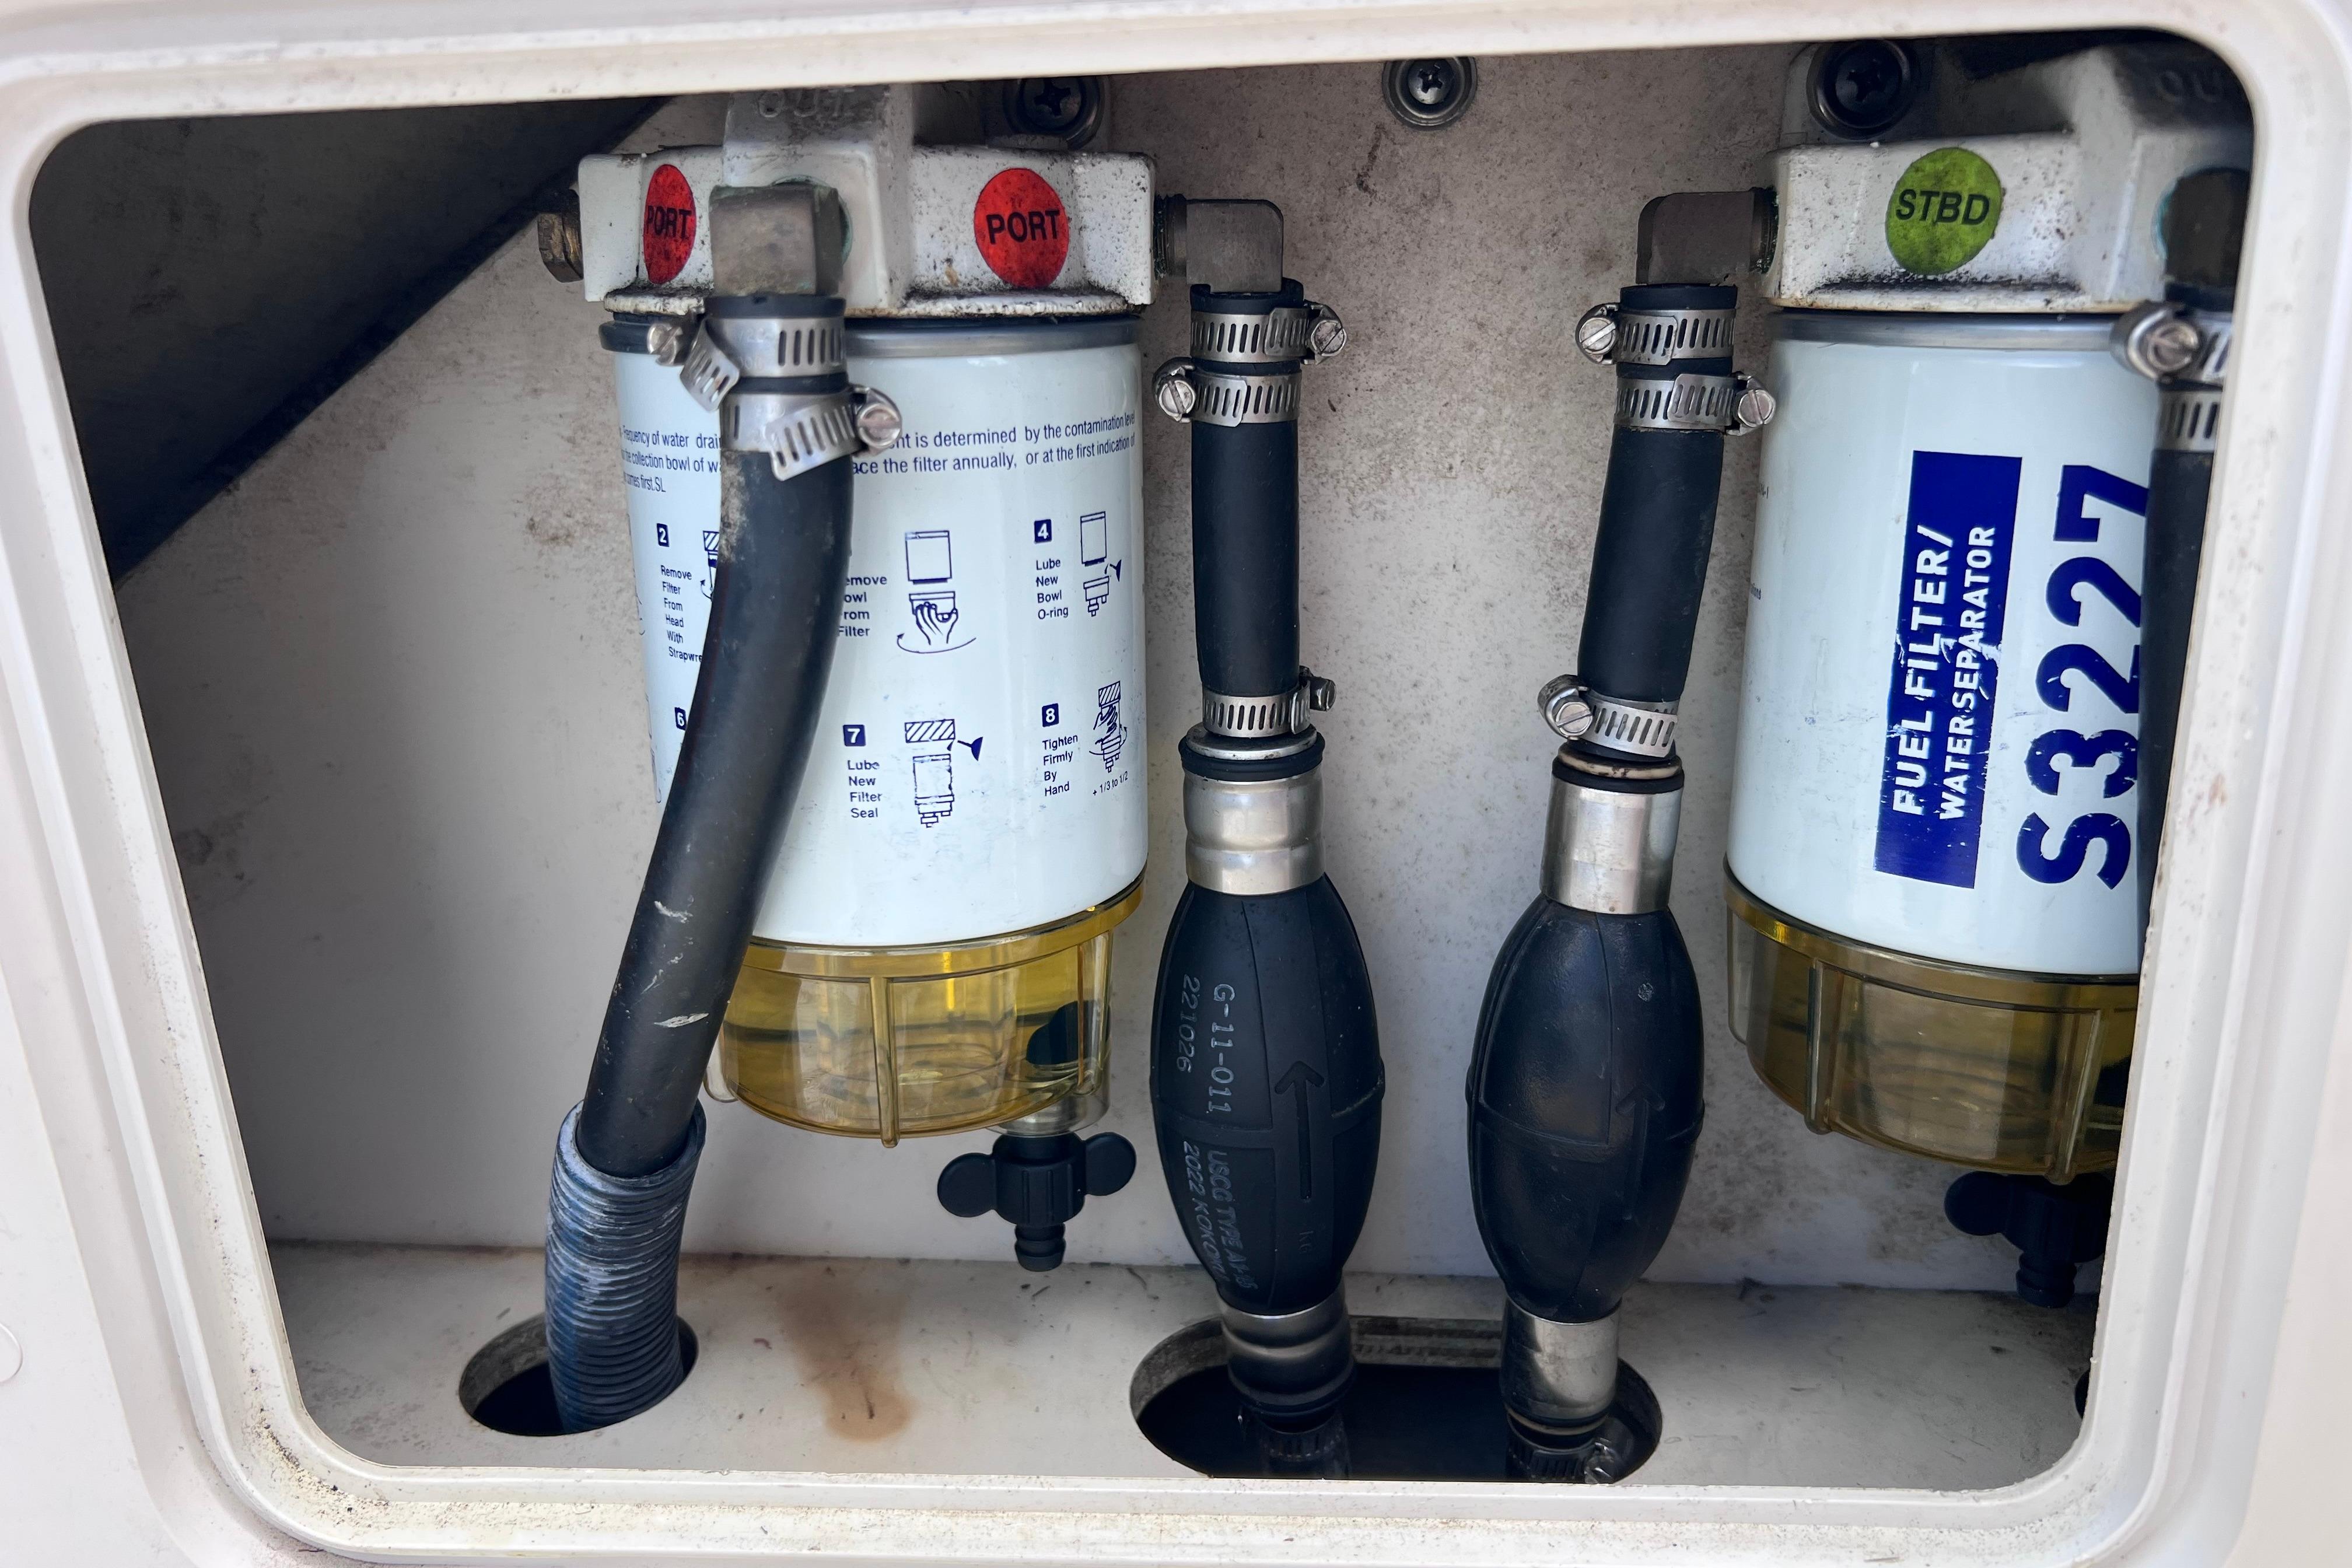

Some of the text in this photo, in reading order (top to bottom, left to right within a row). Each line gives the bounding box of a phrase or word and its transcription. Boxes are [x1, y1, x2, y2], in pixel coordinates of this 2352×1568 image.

[1895, 188, 1989, 226] STBD
[647, 205, 692, 240] PORT
[986, 209, 1061, 244] PORT
[915, 432, 929, 448] is
[933, 427, 1017, 448] determined
[1025, 426, 1040, 444] by
[1044, 424, 1061, 440] the
[1065, 414, 1124, 437] contamination
[652, 430, 660, 445] of
[662, 432, 689, 447] water
[696, 433, 721, 449] drai
[632, 451, 664, 469] collection
[666, 454, 690, 471] bowl
[694, 457, 704, 472] of
[883, 458, 908, 474] the
[914, 456, 948, 472] filter
[953, 452, 1017, 471] annually,
[1026, 452, 1040, 466] or
[1042, 449, 1054, 463] at
[1056, 447, 1073, 461] the
[1077, 443, 1095, 459] first
[1097, 436, 1130, 456] indication
[1036, 558, 1060, 570] Lube
[660, 565, 692, 580] Remove
[662, 581, 681, 595] Filter
[846, 576, 887, 586] emove
[1035, 576, 1058, 587] New
[845, 592, 867, 603] owl
[1037, 590, 1062, 603] Bowl
[664, 598, 684, 612] From
[665, 614, 684, 628] Head
[844, 611, 870, 620] rom
[1038, 607, 1069, 620] O-ring
[666, 630, 684, 644] With
[1892, 524, 1954, 816] FUEL FILTER/
[1940, 526, 1997, 820] WATER SEPARATOR
[2016, 464, 2151, 890] S3227
[1042, 735, 1078, 751] Tighten
[848, 760, 880, 770] Lube
[1043, 751, 1073, 765] Firmly
[849, 776, 876, 786] New
[1044, 771, 1057, 782] By
[1099, 781, 1111, 793] 1/3
[1112, 778, 1118, 788] to
[1119, 771, 1128, 783] 1/2
[1045, 781, 1070, 796] Hand
[850, 792, 883, 802] Filter
[850, 807, 878, 818] Seal
[1176, 974, 1200, 1073] 221026
[1208, 984, 1236, 1112] G-11-011
[1184, 1141, 1206, 1196] 2022
[1208, 1150, 1233, 1202] USCG
[1216, 1206, 1244, 1250] TYPE
